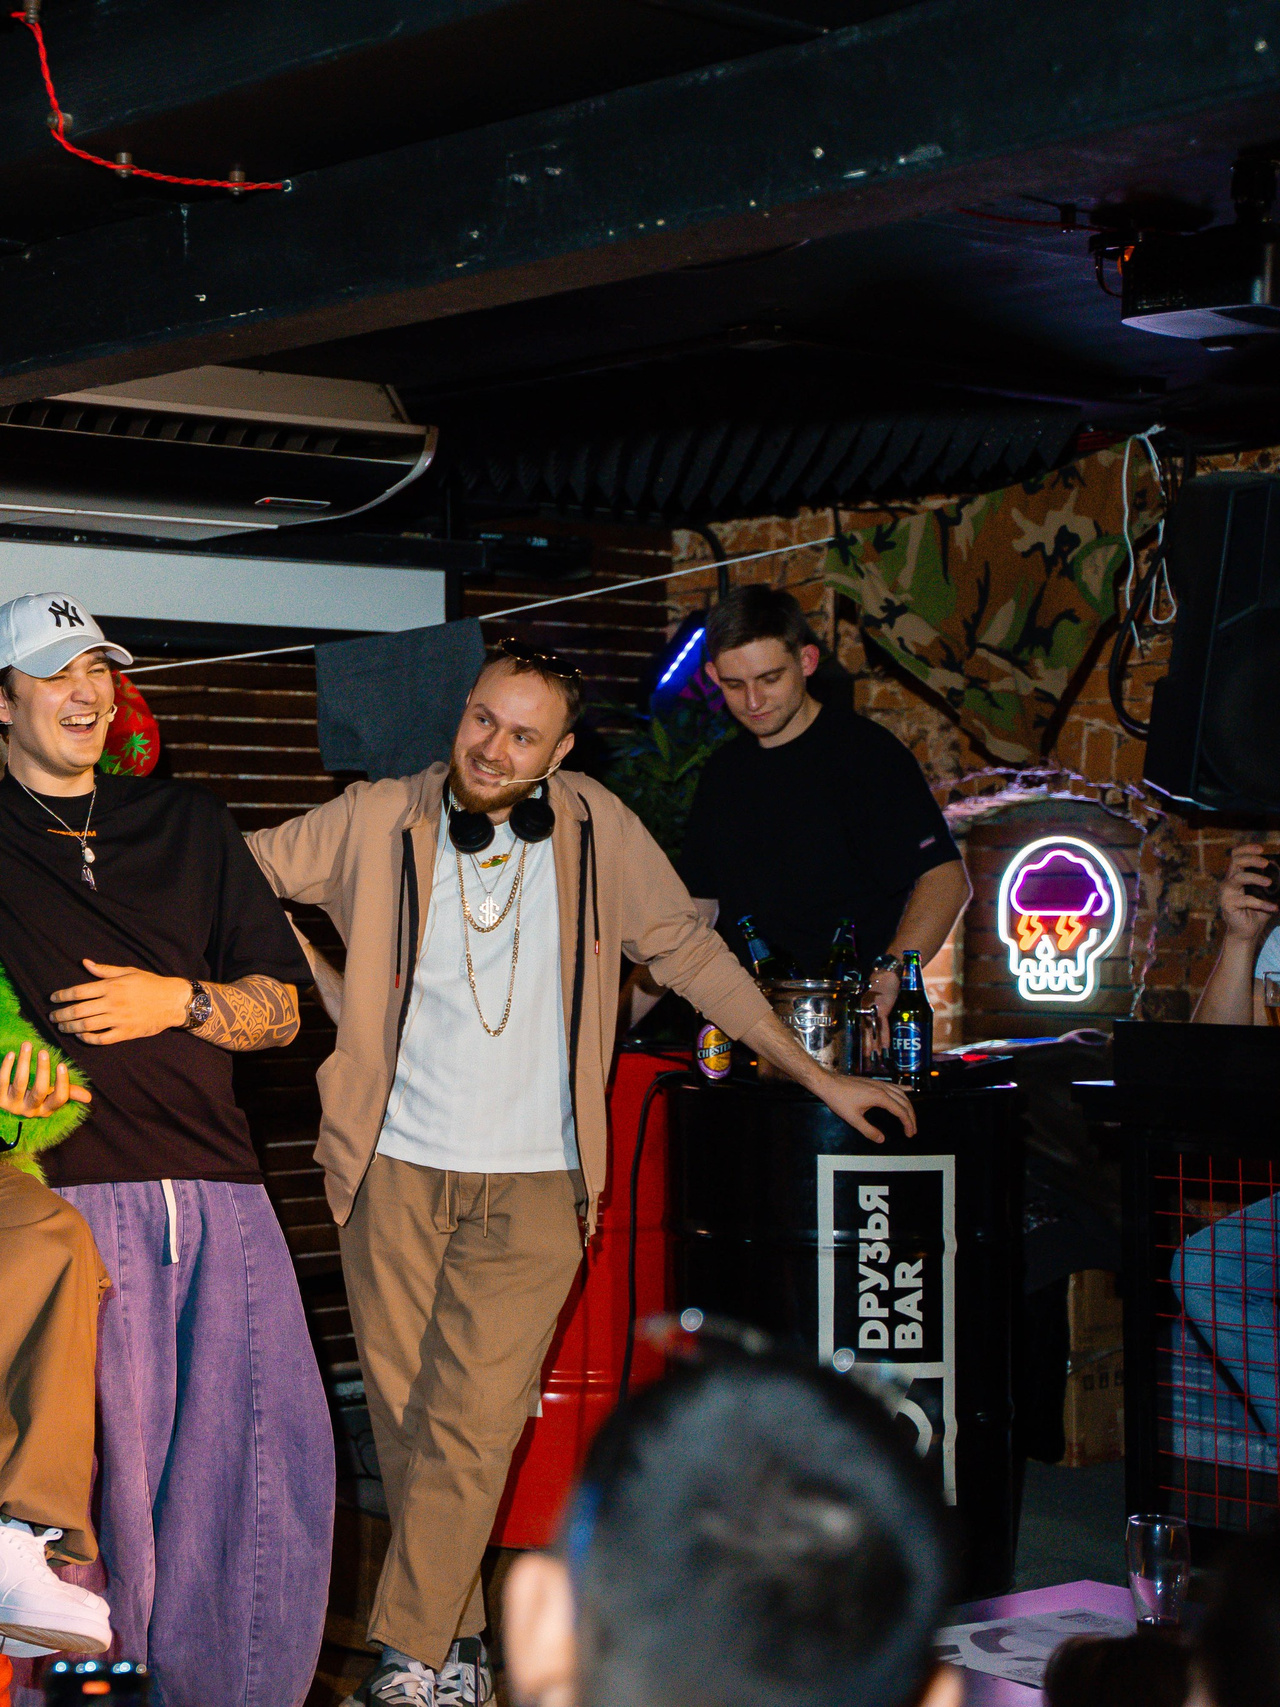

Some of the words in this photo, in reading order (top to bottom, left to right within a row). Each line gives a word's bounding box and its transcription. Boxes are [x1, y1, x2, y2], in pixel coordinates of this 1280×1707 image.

[48, 599, 85, 628] NY
[697, 1041, 733, 1059] CHESTE
[892, 1037, 922, 1051] EFES
[894, 1258, 923, 1349] BAR
